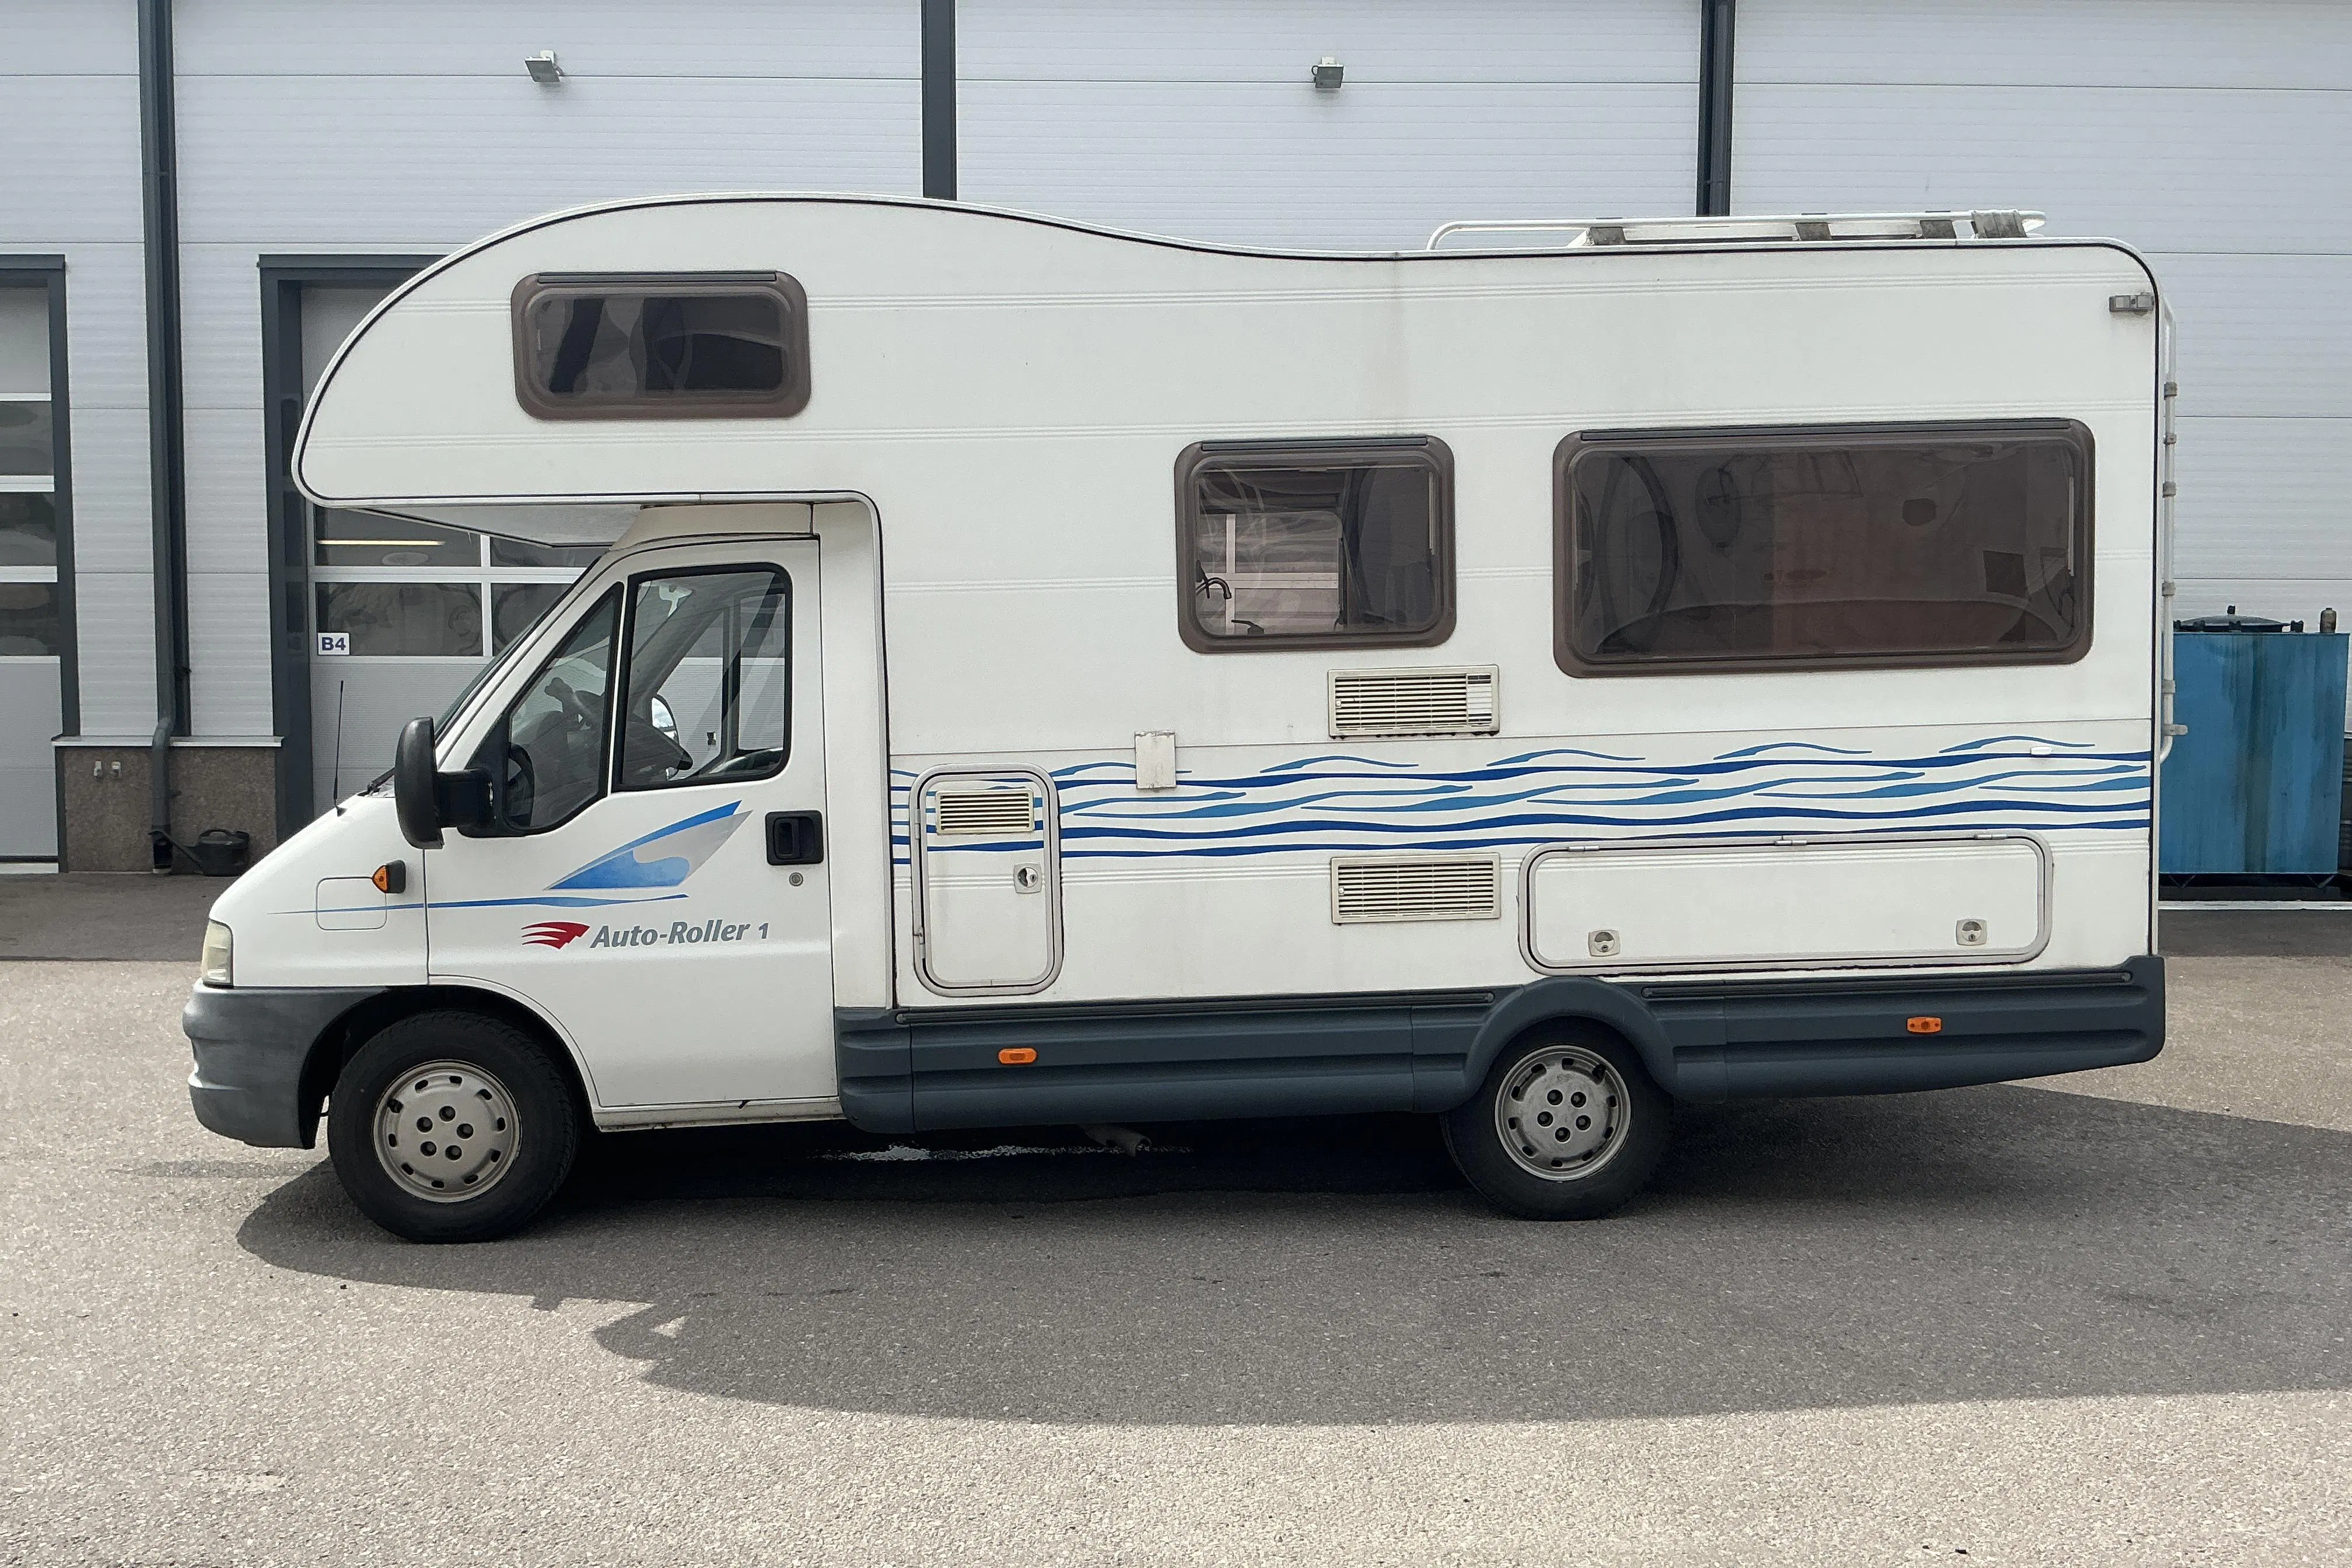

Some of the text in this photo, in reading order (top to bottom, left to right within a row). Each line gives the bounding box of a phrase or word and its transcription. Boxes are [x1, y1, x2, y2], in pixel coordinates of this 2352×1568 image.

[321, 636, 346, 651] B4
[589, 919, 769, 949] Auto-Roller 1
